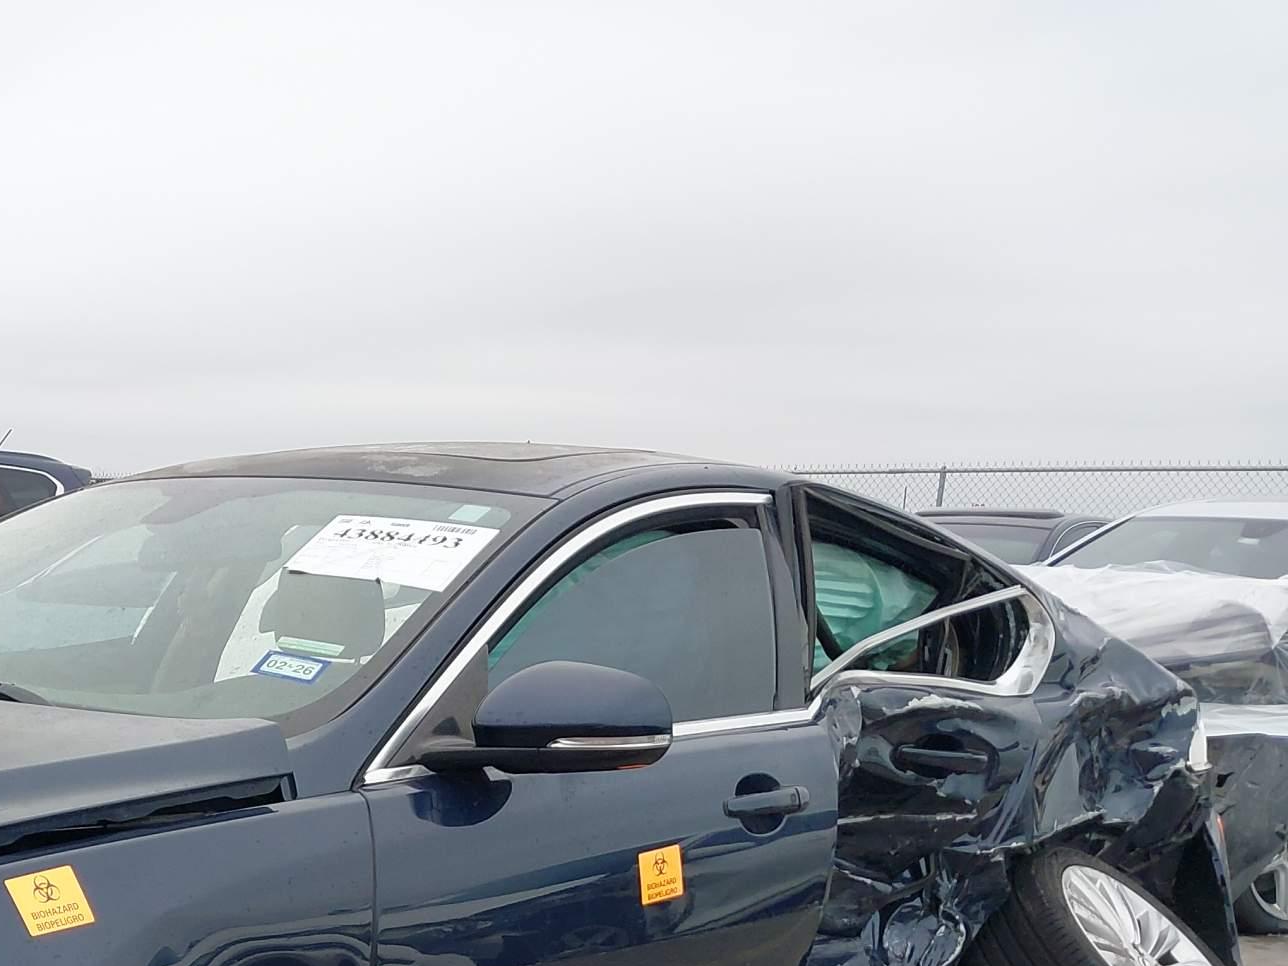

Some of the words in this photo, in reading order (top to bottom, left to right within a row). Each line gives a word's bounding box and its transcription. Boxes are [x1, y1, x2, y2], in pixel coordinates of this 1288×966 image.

[333, 527, 463, 549] 43884493
[31, 902, 79, 920] BIOHAZARD
[36, 913, 85, 932] BIOPELIGRO
